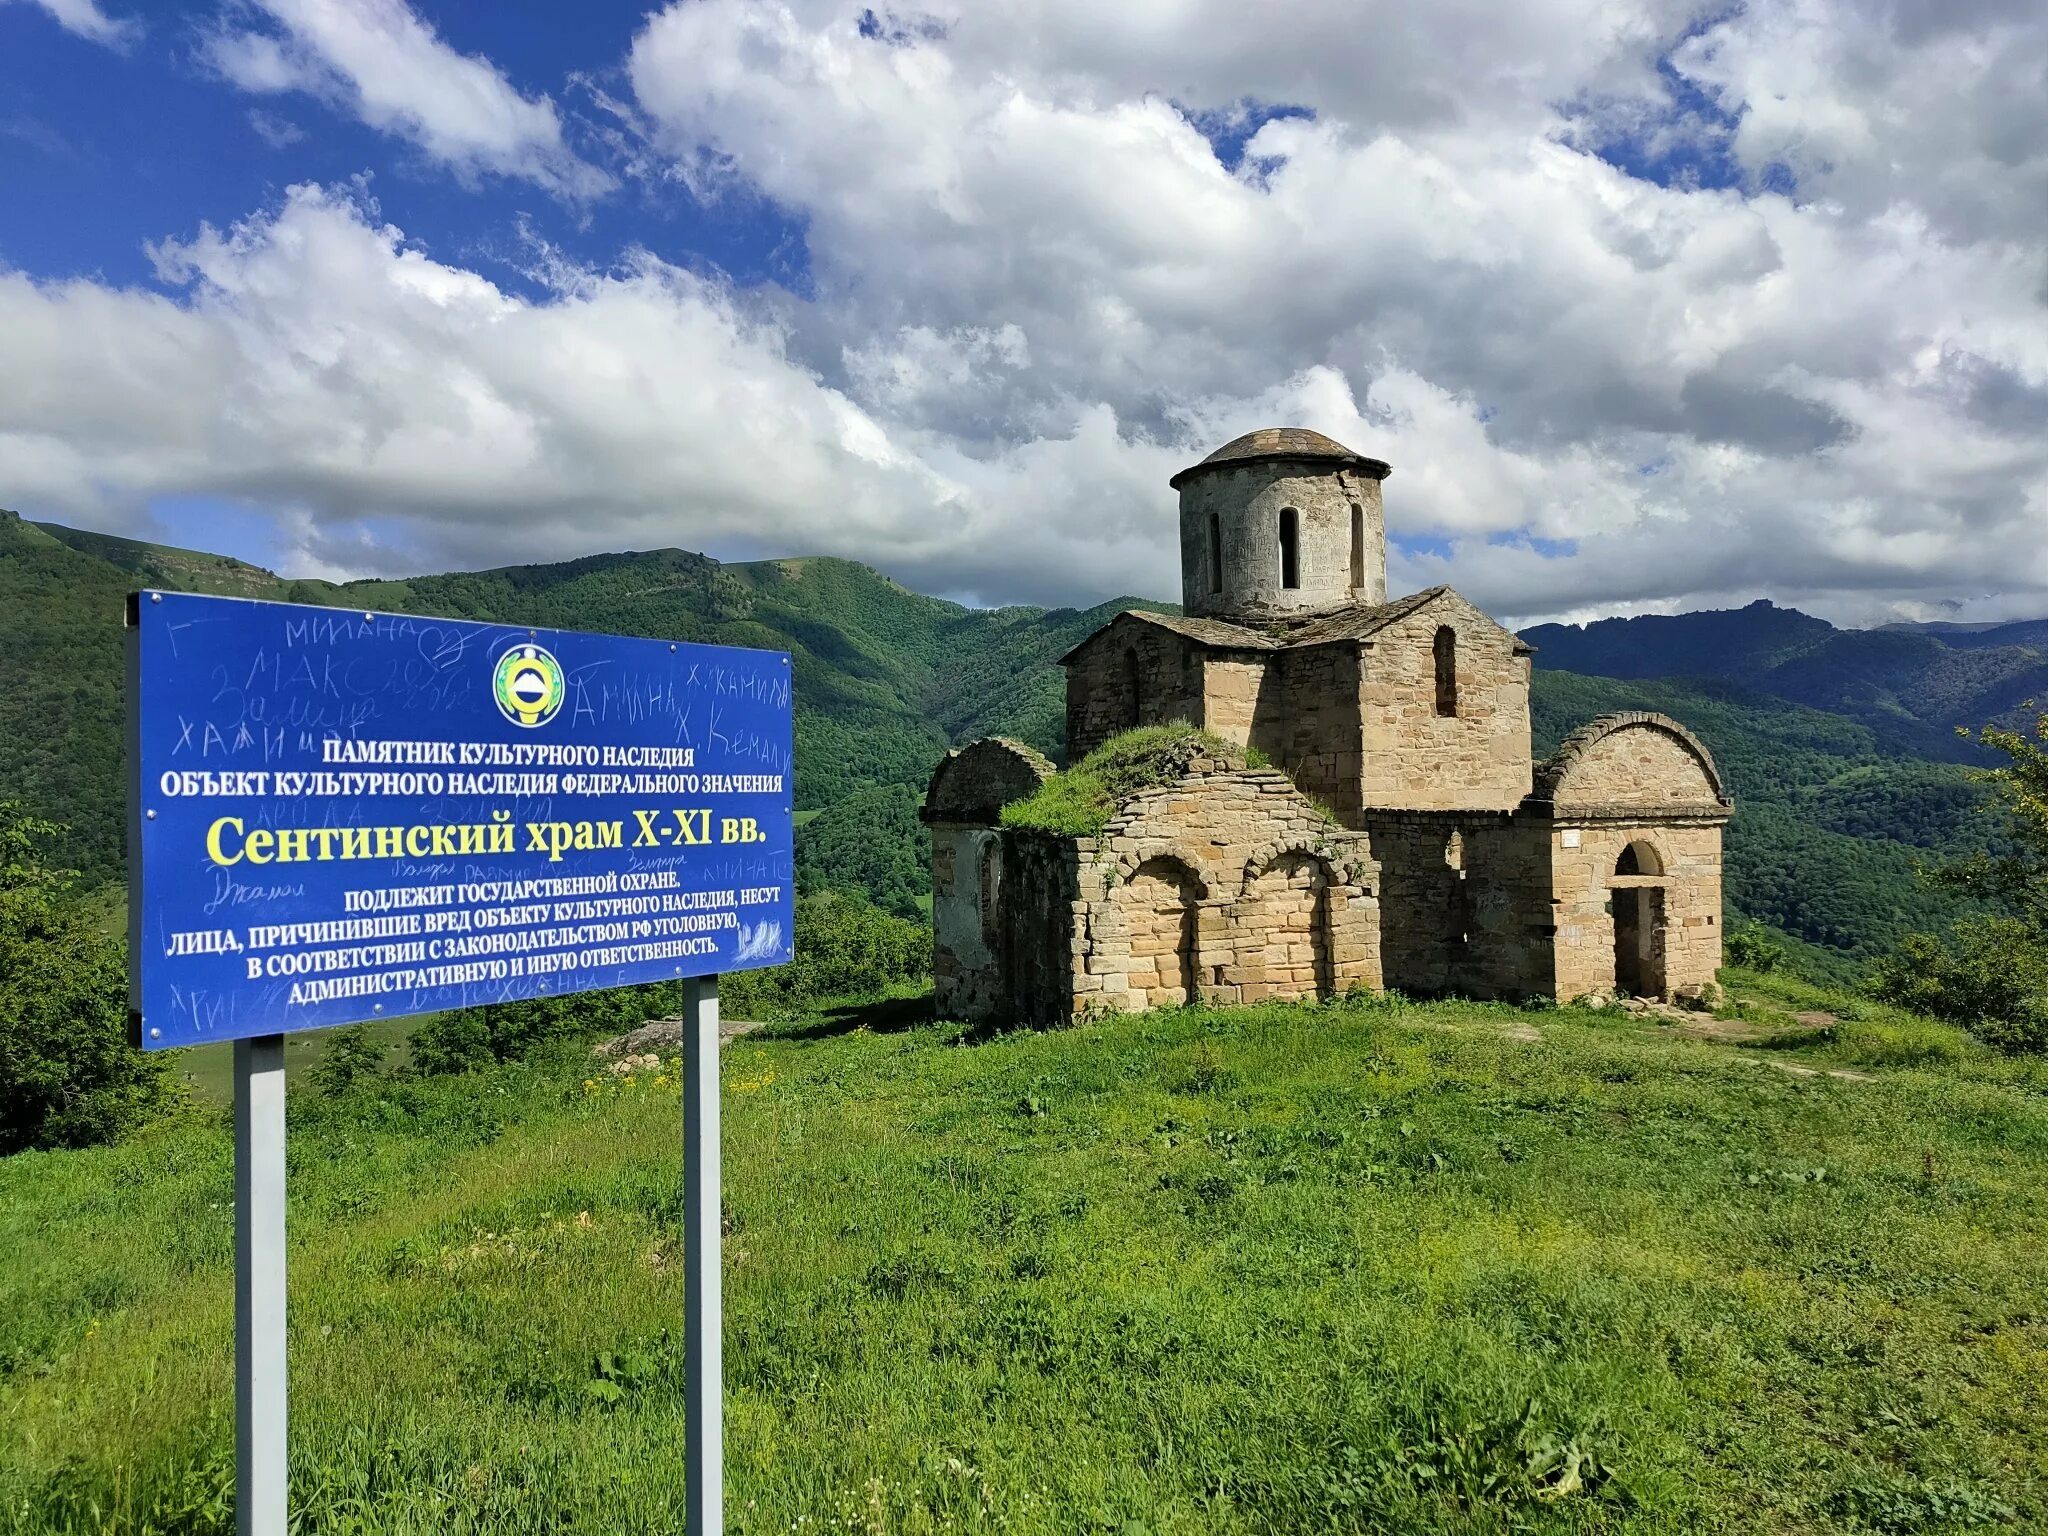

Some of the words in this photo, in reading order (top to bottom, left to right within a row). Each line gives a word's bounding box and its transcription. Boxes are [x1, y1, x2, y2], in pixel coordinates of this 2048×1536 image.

[322, 739, 455, 765] ПАМЯТНИК
[457, 742, 600, 767] КУЛЬТУРНОГО
[602, 746, 695, 770] НАСЛЕДИЯ
[160, 770, 269, 797] ОБЪЕКТ
[274, 772, 444, 796] КУЛЬТУРНОГО
[448, 773, 558, 798] НАСЛЕДИЯ
[561, 774, 700, 798] ФЕДЕРАЛЬНОГО
[702, 775, 783, 793] ЗНАЧЕНИЯ
[206, 810, 516, 866] Сентинский
[525, 820, 623, 861] храм
[720, 816, 767, 844] вв.
[344, 885, 455, 912] ПОДЛЕЖИТ
[458, 871, 618, 904] ГОСУДАРСТВЕННОЙ
[620, 871, 681, 892] ОХРАНЕ.
[166, 929, 245, 957] ЛИЦА,
[248, 912, 421, 949] ПРИЧИНИВШИЕ
[424, 904, 471, 934] ВРЕД
[473, 903, 551, 929] ОБЪЕКТУ
[554, 896, 660, 922] КУЛЬТУРНОГО
[663, 889, 739, 912] НАСЛЕДИЯ,
[740, 886, 781, 906] НЕСУТ
[247, 957, 262, 979] В
[266, 943, 426, 977] СООТВЕТСТВИИ
[429, 940, 442, 957] С
[444, 925, 629, 958] ЗАКОНОДАТЕЛЬСТВОМ
[632, 920, 652, 939] РФ
[654, 911, 741, 935] УГОЛОВНУЮ,
[288, 959, 508, 1006] АДМИНИСТРАТИВНУЮ
[510, 956, 525, 978] И
[527, 949, 578, 974] ИНУЮ
[580, 936, 719, 967] ОТВЕТСТВЕННОСТЬ.
